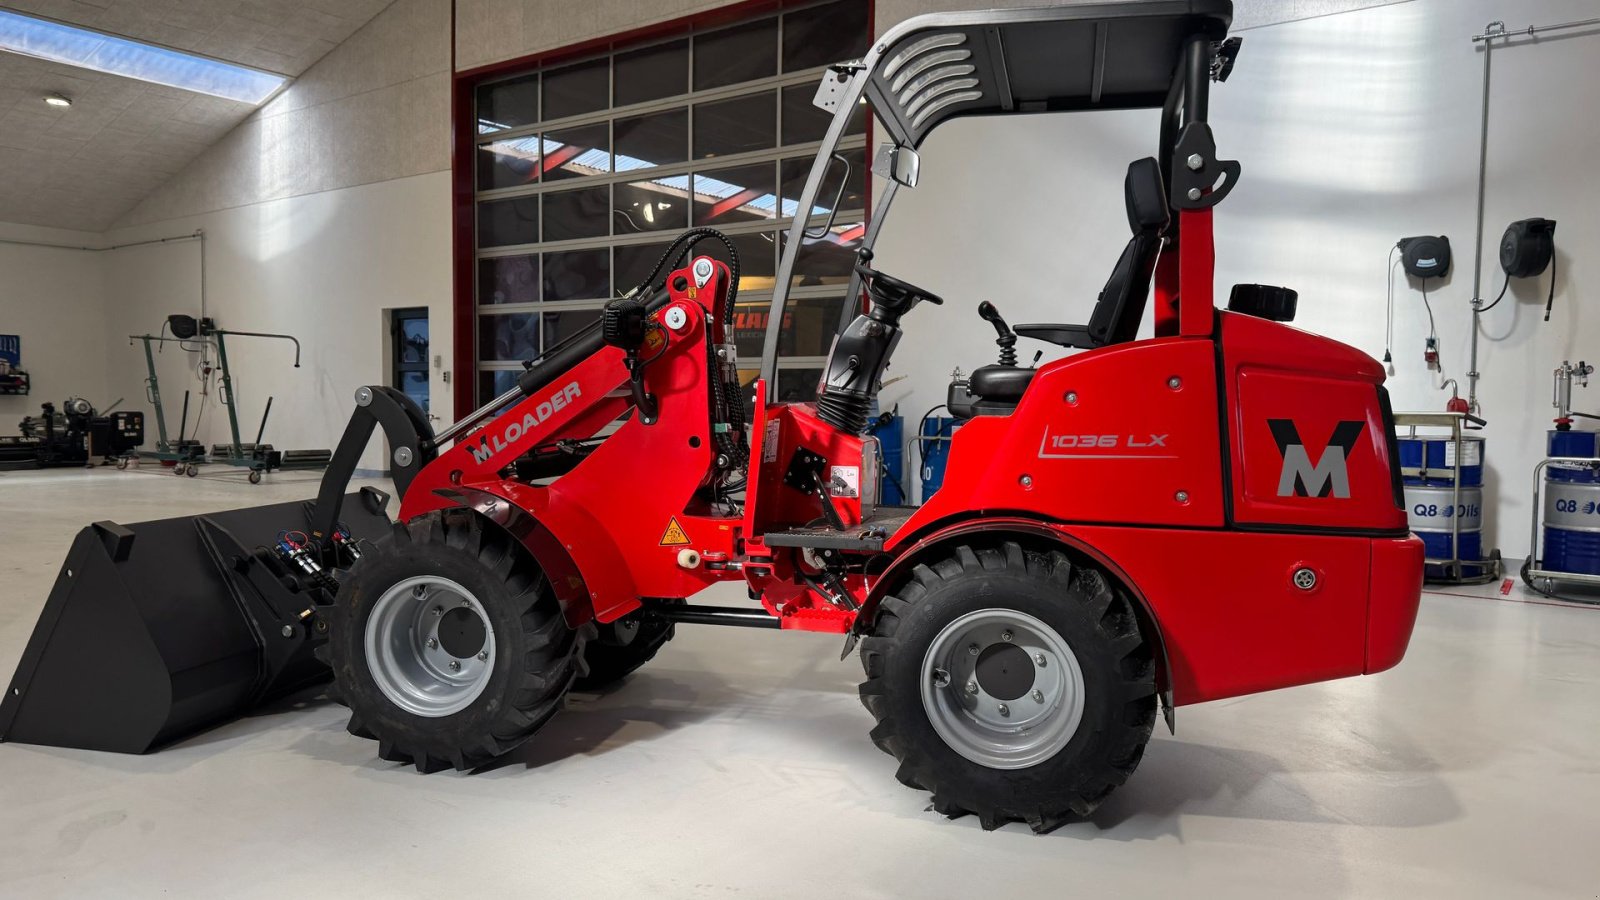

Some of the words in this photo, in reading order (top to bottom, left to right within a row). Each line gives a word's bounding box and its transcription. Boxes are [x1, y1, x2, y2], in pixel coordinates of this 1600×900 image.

[492, 381, 582, 452] LOADER
[1051, 434, 1119, 448] 1036
[1126, 434, 1169, 447] LX
[1414, 504, 1438, 517] Q8
[1556, 498, 1577, 513] Q8
